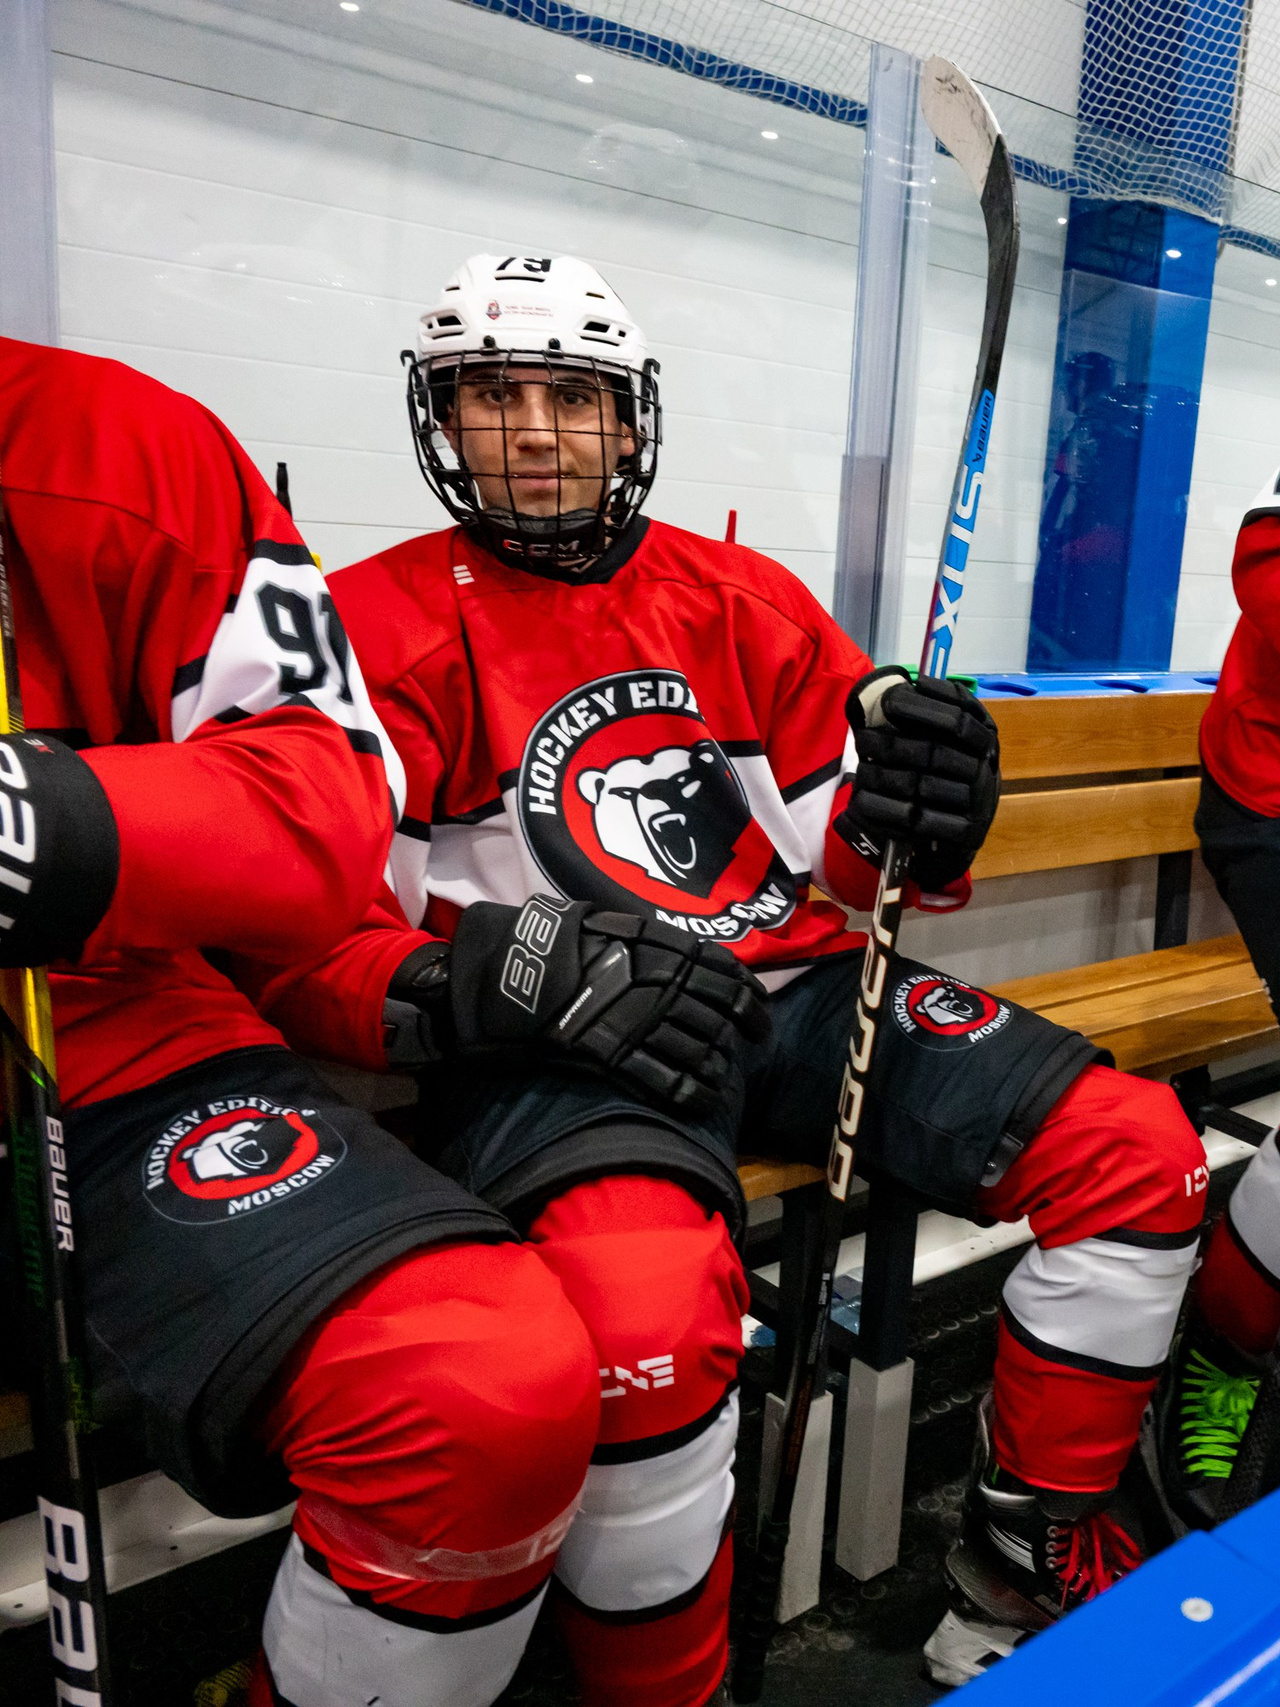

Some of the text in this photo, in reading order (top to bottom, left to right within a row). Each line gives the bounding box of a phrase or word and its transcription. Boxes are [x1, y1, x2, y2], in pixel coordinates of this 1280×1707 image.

[976, 394, 992, 451] BAUER
[922, 463, 984, 680] EXUS
[528, 687, 618, 815] HOCKEY
[558, 986, 593, 1030] SUPREME
[827, 868, 902, 1202] BAUER
[893, 982, 918, 1033] HOCKEY
[967, 1004, 1011, 1043] MOSCOW
[45, 1115, 75, 1253] BAUER
[146, 1109, 202, 1190] HOCKEY
[228, 1154, 336, 1215] MOSCOW
